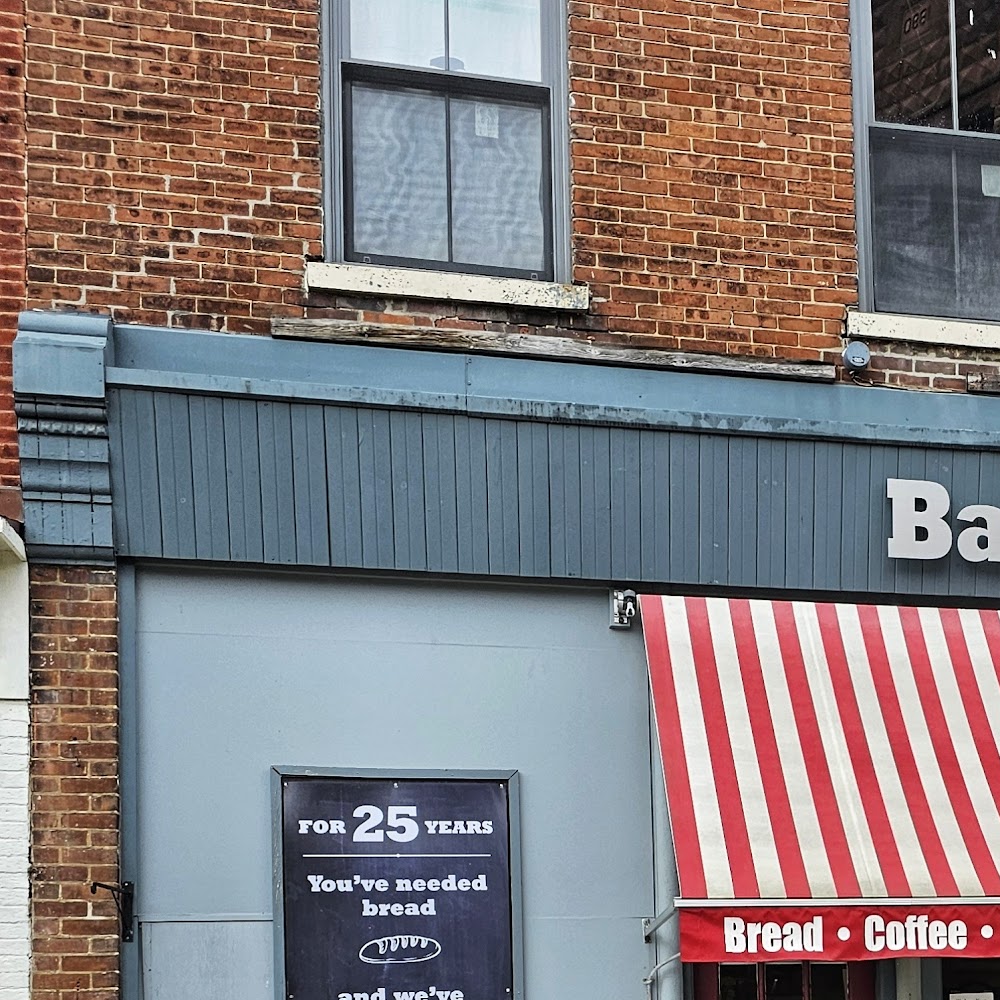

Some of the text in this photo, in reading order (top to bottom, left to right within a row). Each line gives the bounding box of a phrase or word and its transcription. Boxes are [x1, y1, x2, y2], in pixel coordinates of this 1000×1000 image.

[298, 804, 493, 842] FOR 25 YEARS
[307, 874, 488, 892] You've needed
[361, 898, 436, 916] bread
[723, 915, 824, 953] Bread
[864, 914, 967, 952] Coffee
